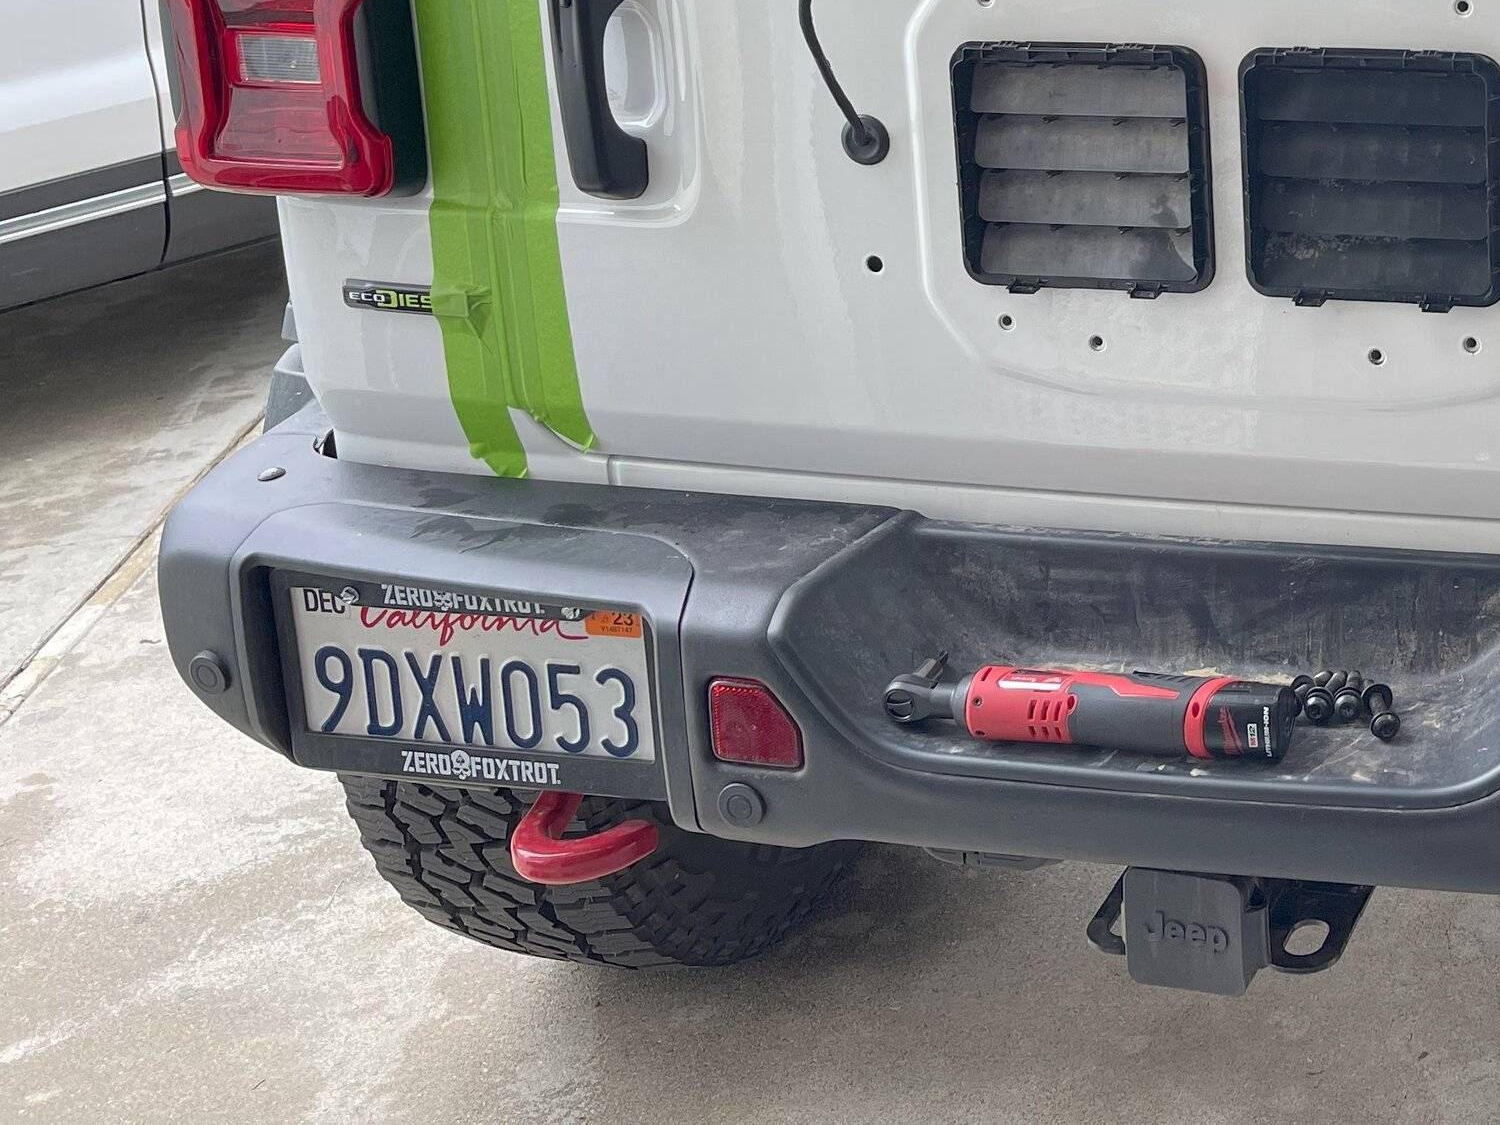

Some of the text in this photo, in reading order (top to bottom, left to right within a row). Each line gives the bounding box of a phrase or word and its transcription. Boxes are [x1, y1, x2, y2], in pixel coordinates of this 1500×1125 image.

[303, 588, 346, 615] DEC
[381, 584, 433, 607] ZERO
[314, 646, 640, 758] 9DXW053
[401, 751, 451, 776] ZERO
[1142, 910, 1229, 954] Jeep
